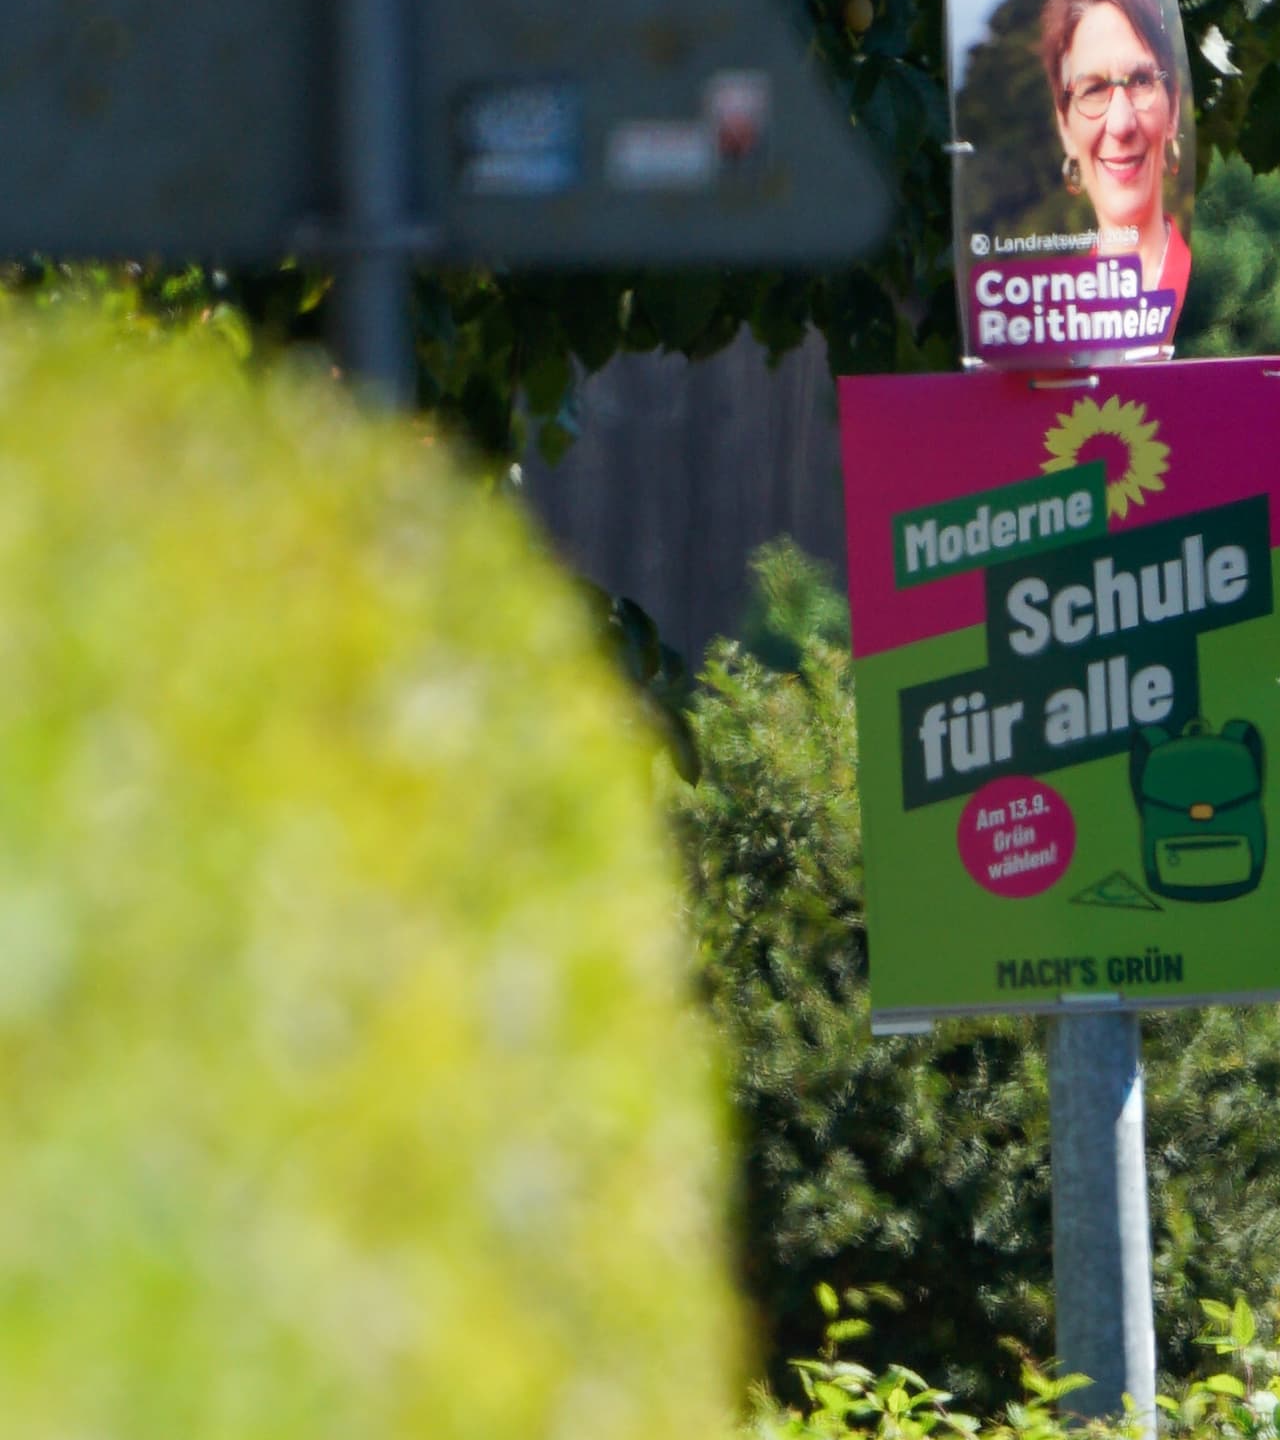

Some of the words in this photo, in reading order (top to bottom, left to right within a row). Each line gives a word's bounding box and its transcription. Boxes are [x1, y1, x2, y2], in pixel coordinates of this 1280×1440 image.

[975, 260, 1138, 307] Cornelia
[979, 297, 1172, 345] Reithmeier
[904, 490, 1093, 573] Moderne
[1006, 533, 1249, 656] Schule
[919, 691, 1025, 782] für
[1045, 655, 1175, 747] alle
[976, 808, 1005, 831] Am
[1009, 793, 1051, 821] 13.9.
[993, 824, 1036, 853] Grün
[996, 956, 1099, 990] MACH'S
[1107, 946, 1184, 985] GRÜN
